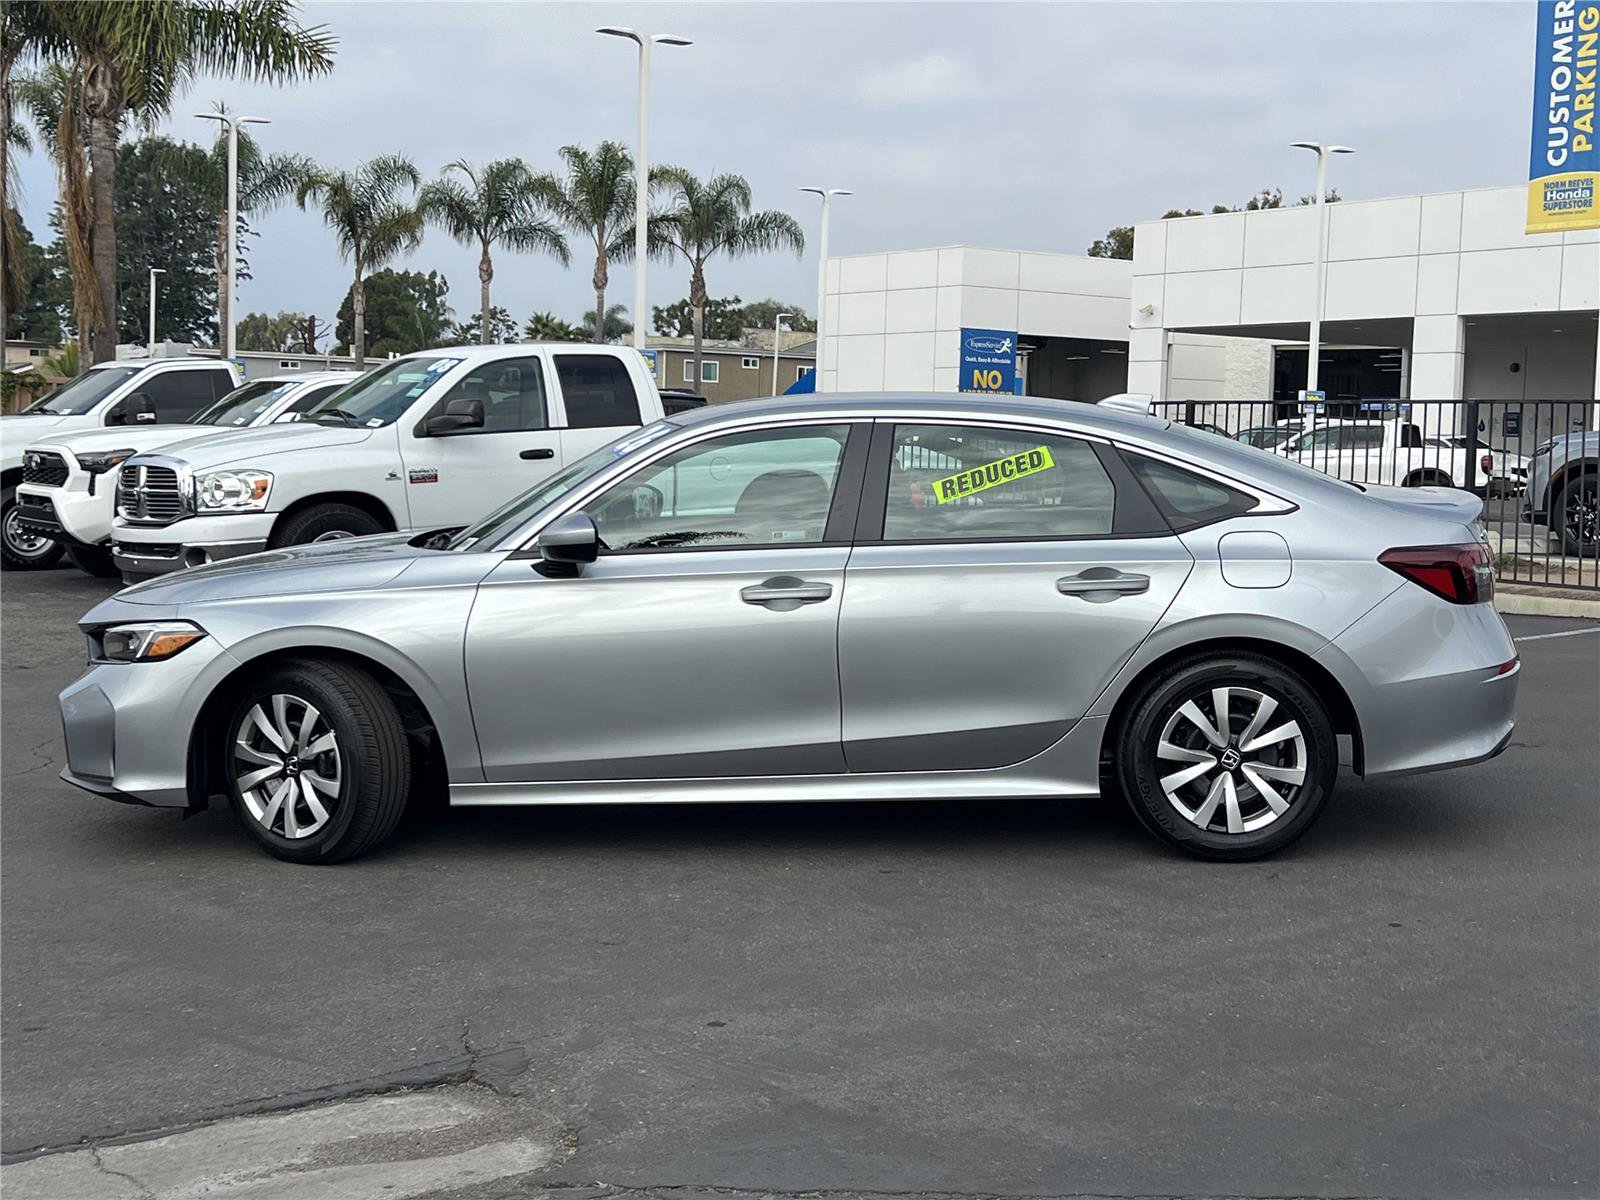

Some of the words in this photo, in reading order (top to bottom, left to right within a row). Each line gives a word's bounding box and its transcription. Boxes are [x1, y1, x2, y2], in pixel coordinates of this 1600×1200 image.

[1546, 0, 1576, 167] CUSTOMER
[1572, 6, 1600, 153] PARKING
[1544, 180, 1567, 190] NORM
[1568, 178, 1594, 188] REEVES
[1546, 188, 1590, 201] Honda
[1543, 199, 1593, 211] SUPERSTORE
[973, 369, 1002, 390] NO
[940, 450, 1044, 499] REDUCED
